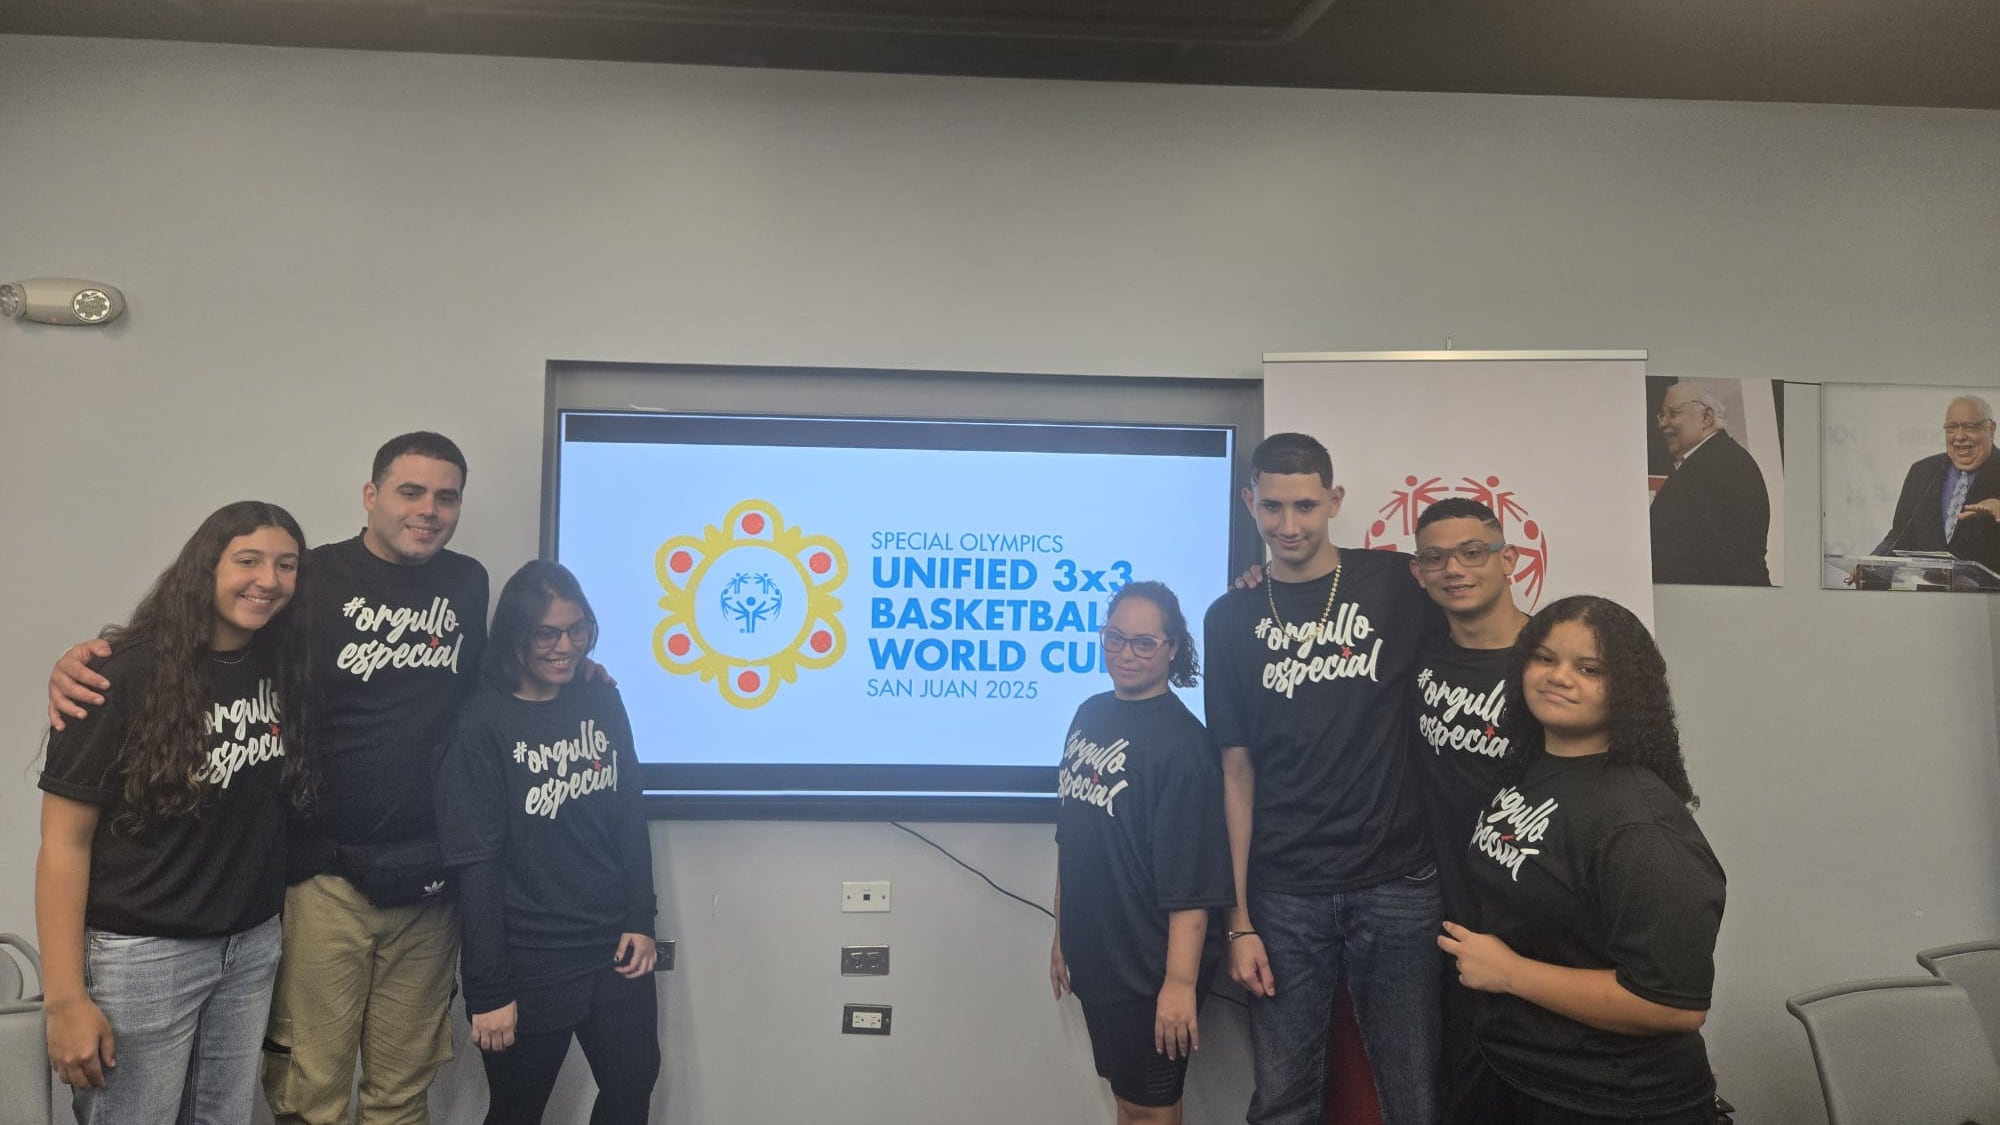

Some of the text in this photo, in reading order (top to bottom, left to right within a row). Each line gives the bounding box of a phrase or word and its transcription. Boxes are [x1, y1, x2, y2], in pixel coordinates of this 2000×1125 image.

[871, 531, 1063, 553] SPECIAL OLYMPICS
[872, 556, 1134, 593] UNIFIED 3x3
[342, 596, 460, 644] #orgullo
[871, 597, 1102, 633] BASKETBAL
[1254, 602, 1375, 659] #orgullo
[336, 632, 465, 682] especial
[868, 638, 1027, 671] WORLD
[1262, 638, 1384, 699] especial
[867, 678, 1039, 699] SAN JUAN 2025
[1417, 668, 1507, 728] #orgull
[512, 719, 610, 777] #orgullo
[1419, 713, 1510, 759] especia
[525, 749, 618, 820] especial
[1057, 767, 1129, 817] special
